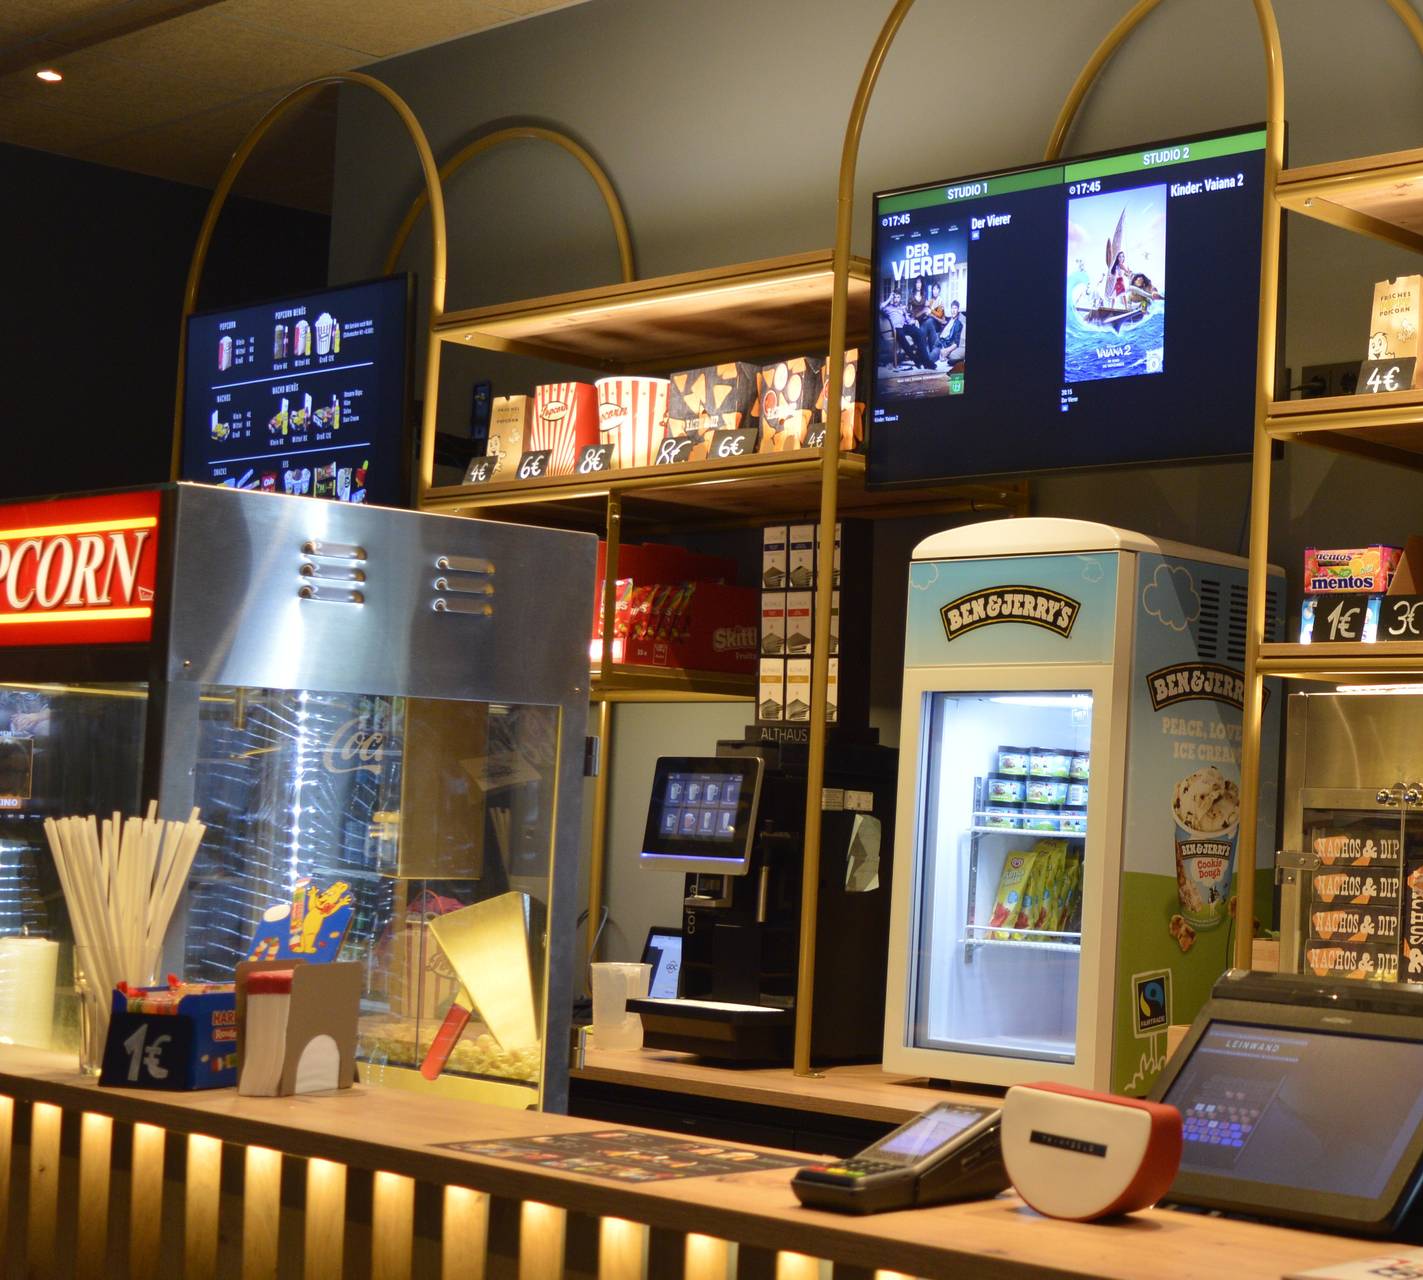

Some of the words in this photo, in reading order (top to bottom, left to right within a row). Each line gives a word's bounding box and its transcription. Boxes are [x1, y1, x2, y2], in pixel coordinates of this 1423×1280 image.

[1143, 150, 1179, 166] STUDIO
[1182, 147, 1190, 161] 2
[947, 185, 982, 201] STUDIO
[983, 183, 989, 196] 1
[1075, 181, 1101, 195] 17:45
[1170, 181, 1203, 198] Kinder:
[1204, 176, 1235, 193] Vaiana
[1237, 174, 1244, 188] 2
[888, 214, 911, 227] 17:45
[971, 218, 985, 230] Der
[986, 214, 1012, 228] Vierer
[905, 243, 930, 259] DER
[891, 252, 957, 281] VIERER
[1366, 366, 1400, 394] 4€
[718, 436, 745, 458] 6€
[807, 430, 826, 448] 4€
[470, 461, 487, 481] 4€
[520, 455, 545, 480] 6€
[580, 448, 606, 474] 8€
[1311, 576, 1374, 590] mentos
[1327, 600, 1360, 640] 1€
[760, 727, 808, 743] ALTHAUS
[1162, 716, 1207, 738] PEACE,
[1173, 741, 1196, 760] ICE
[1317, 837, 1361, 860] NACHOS
[1362, 838, 1378, 857] &
[1380, 838, 1400, 858] DIP
[1197, 858, 1223, 871] Cookie
[1199, 868, 1222, 881] Dough
[1316, 875, 1361, 898] NACHOS
[1362, 877, 1378, 897] &
[1379, 876, 1400, 898] DIP
[1314, 912, 1360, 935] NACHOS
[1360, 915, 1376, 936] &
[1377, 913, 1399, 936] DIP
[1309, 947, 1357, 971] NACHOS
[1357, 951, 1376, 972] &
[1377, 950, 1399, 971] DIP
[123, 1023, 172, 1082] 1€
[1226, 1038, 1280, 1053] LEINWAND
